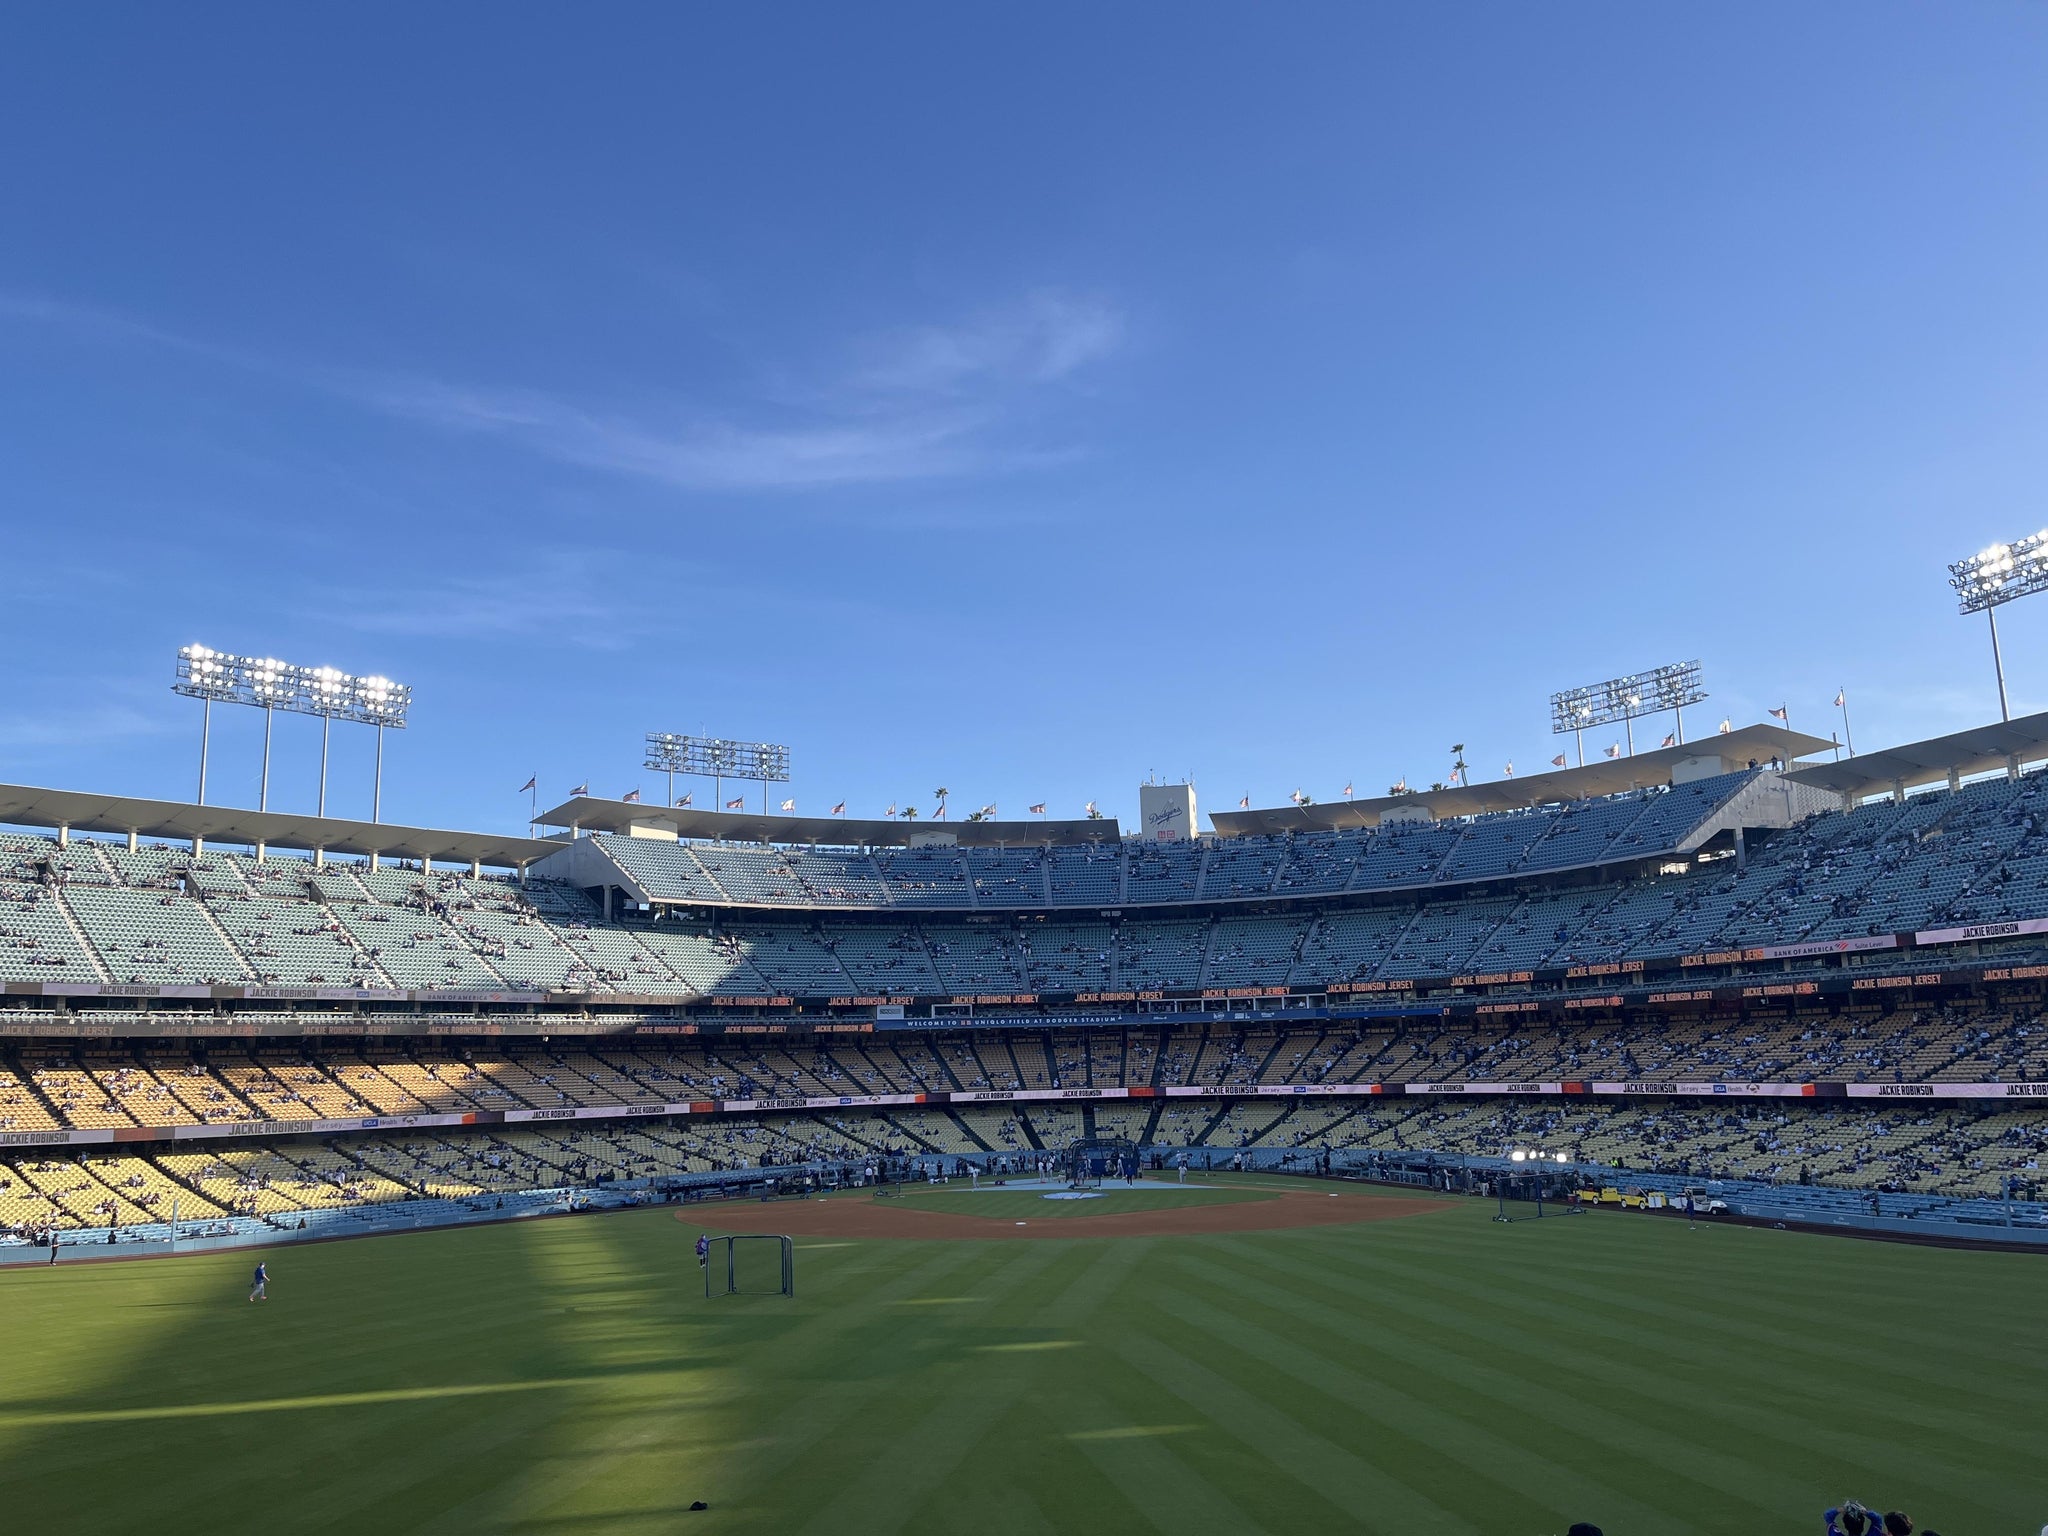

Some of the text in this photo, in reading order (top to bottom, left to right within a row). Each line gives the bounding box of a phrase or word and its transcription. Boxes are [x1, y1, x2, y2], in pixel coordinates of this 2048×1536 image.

[1149, 807, 1183, 825] Dodgers
[1963, 923, 2019, 938] JACKIE ROBINSON
[1803, 946, 1834, 955] AMERICA
[1680, 955, 1704, 967] JACKIE
[1706, 951, 1741, 964] ROBINSON
[1566, 961, 1644, 978] JACKIE ROBINSON JERSEY
[1983, 969, 2010, 980] JACKIE
[1450, 972, 1534, 986] JACKIE ROBINSON JERSEY
[1852, 974, 1941, 989] JACKIE ROBINSON JERSEY
[98, 986, 160, 996] JACKIE ROBINSON
[1326, 980, 1414, 993] JACKIE ROBINSON JERSEY
[1742, 983, 1819, 997] JACKIE ROBINSON JERSEY
[250, 988, 278, 997] JACKIE
[280, 988, 317, 998] ROBINSON
[1074, 991, 1163, 1002] JACKIE ROBINSON JERSEY
[1201, 986, 1290, 998] JACKIE ROBINSON JERSEY
[1648, 991, 1713, 1003] JACKIE ROBINSON JERSEY
[711, 997, 794, 1006] JACKIE ROBINSON JERSEY
[828, 996, 915, 1006] JACKIE ROBINSON JERSEY
[951, 995, 1039, 1004] JACKIE ROBINSON JERSEY
[1475, 1003, 1539, 1014] JACKIE ROBINSON JERSEY
[0, 1026, 113, 1036] JACKIE ROBINSON JERSEY
[160, 1026, 263, 1036] JACKIE ROBINSON JERSEY
[301, 1026, 391, 1035] JACKIE ROBINSON JERSEY
[1201, 1086, 1224, 1095] JACKIE
[1225, 1086, 1259, 1094] ROBINSON
[1521, 1084, 1540, 1092] ROBINSON
[1623, 1083, 1644, 1093] JACKIE
[1645, 1084, 1678, 1093] ROBINSON
[1878, 1085, 1934, 1095] JACKIE ROBINSON
[2006, 1085, 2032, 1095] JACKIE
[1062, 1090, 1078, 1098] JACKIE
[755, 1100, 776, 1109] JACKIE
[776, 1099, 807, 1108] ROBINSON
[532, 1110, 576, 1119] JACKIE ROBINSON
[625, 1106, 665, 1115] JACKIE ROBINSON
[228, 1123, 263, 1135] JACKIE
[265, 1121, 313, 1133] ROBINSON
[0, 1133, 70, 1145] JACKIE ROBINSON
